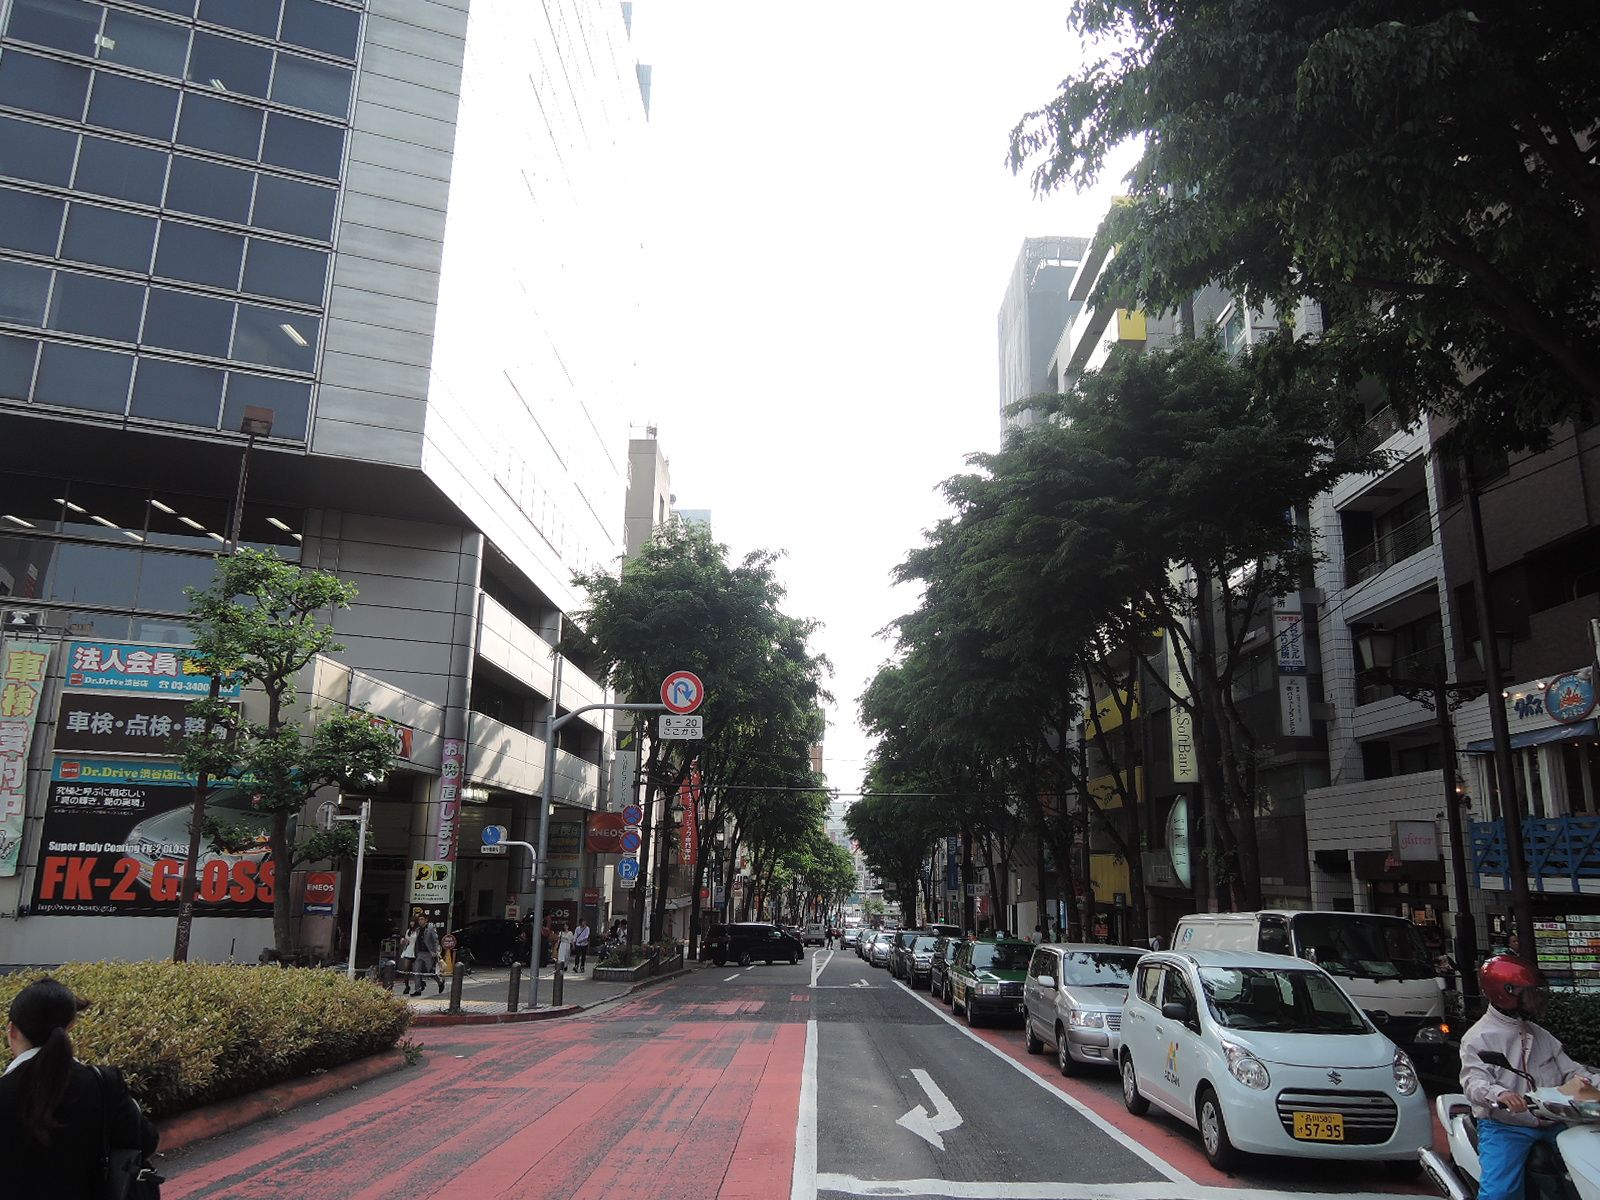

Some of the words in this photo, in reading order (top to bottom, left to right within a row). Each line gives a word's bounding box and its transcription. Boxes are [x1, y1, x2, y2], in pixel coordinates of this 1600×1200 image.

[72, 647, 179, 676] 法人会員
[664, 728, 698, 737] ここから
[1177, 717, 1192, 776] SoftBank
[49, 841, 78, 853] Super
[79, 842, 102, 854] Body
[104, 842, 140, 854] Coating
[1401, 833, 1433, 849] glitter
[39, 856, 141, 901] FK-2
[150, 858, 275, 904] GOSS
[307, 883, 335, 892] ENEOS
[1305, 1123, 1341, 1138] 57-95
